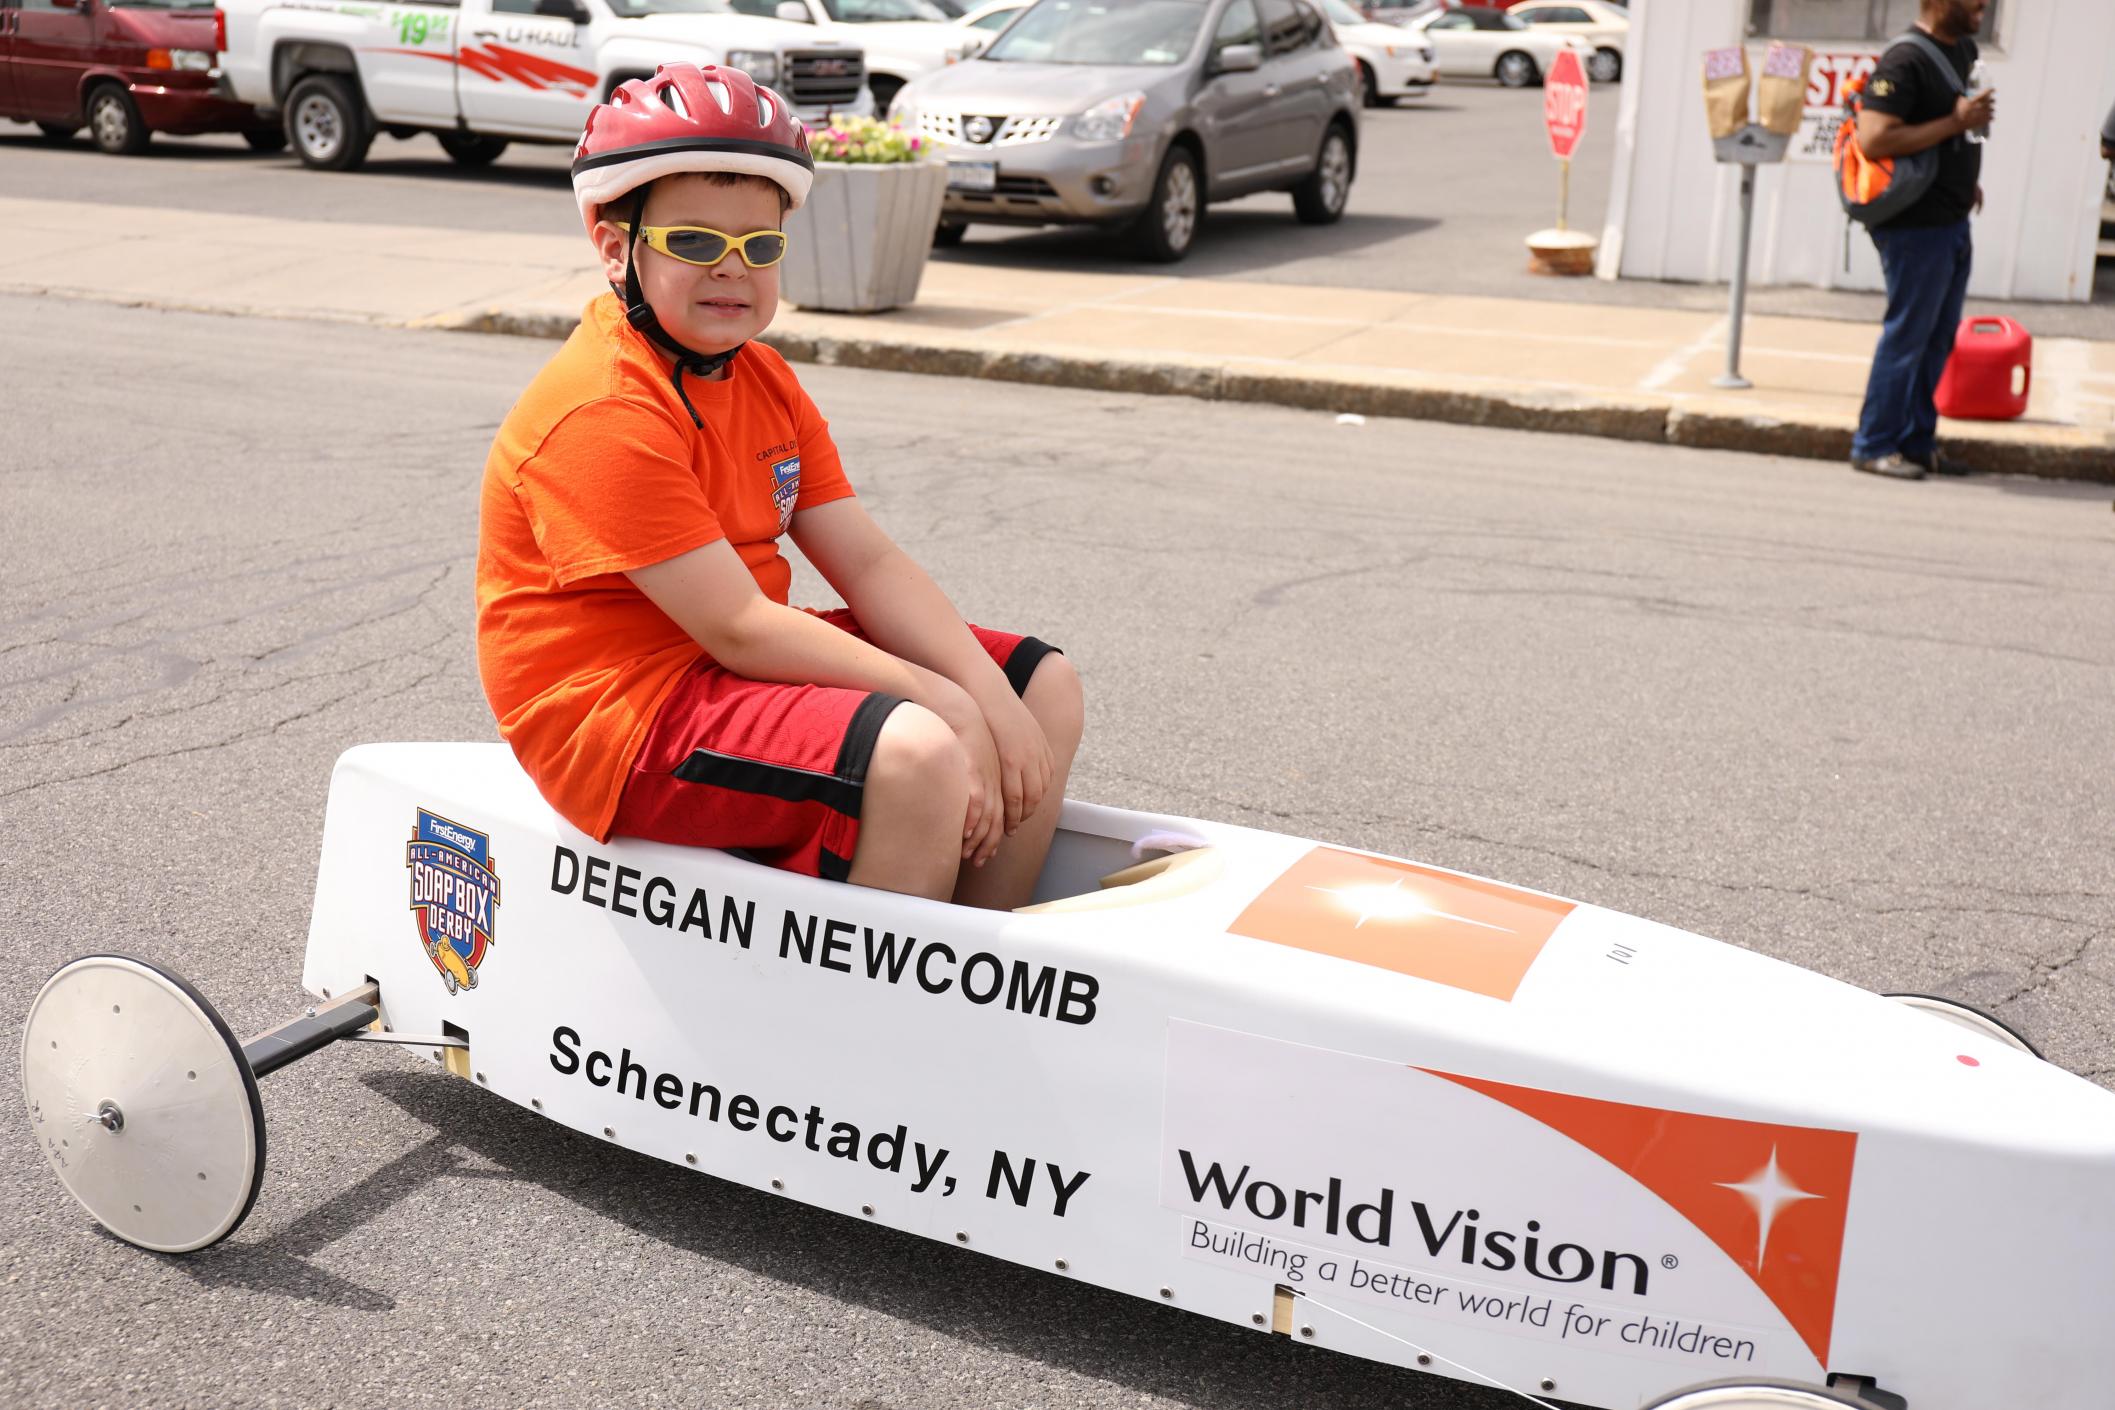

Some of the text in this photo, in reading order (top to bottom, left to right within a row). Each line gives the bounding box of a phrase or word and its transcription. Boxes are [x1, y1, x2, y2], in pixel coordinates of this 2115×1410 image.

[1545, 82, 1585, 125] STOP
[757, 443, 788, 461] CAPITAL
[430, 819, 476, 850] FirstEnergy
[410, 847, 497, 893] ALL-AMERICAN
[414, 861, 489, 931] SOAP BOX
[429, 903, 473, 944] DERBY
[551, 845, 1100, 1025] DEEGAN NEWCOMB
[549, 1025, 1092, 1217] Schenectady, NY
[1178, 1148, 1649, 1296] World Vision
[1191, 1221, 1755, 1361] Building a better world for children
